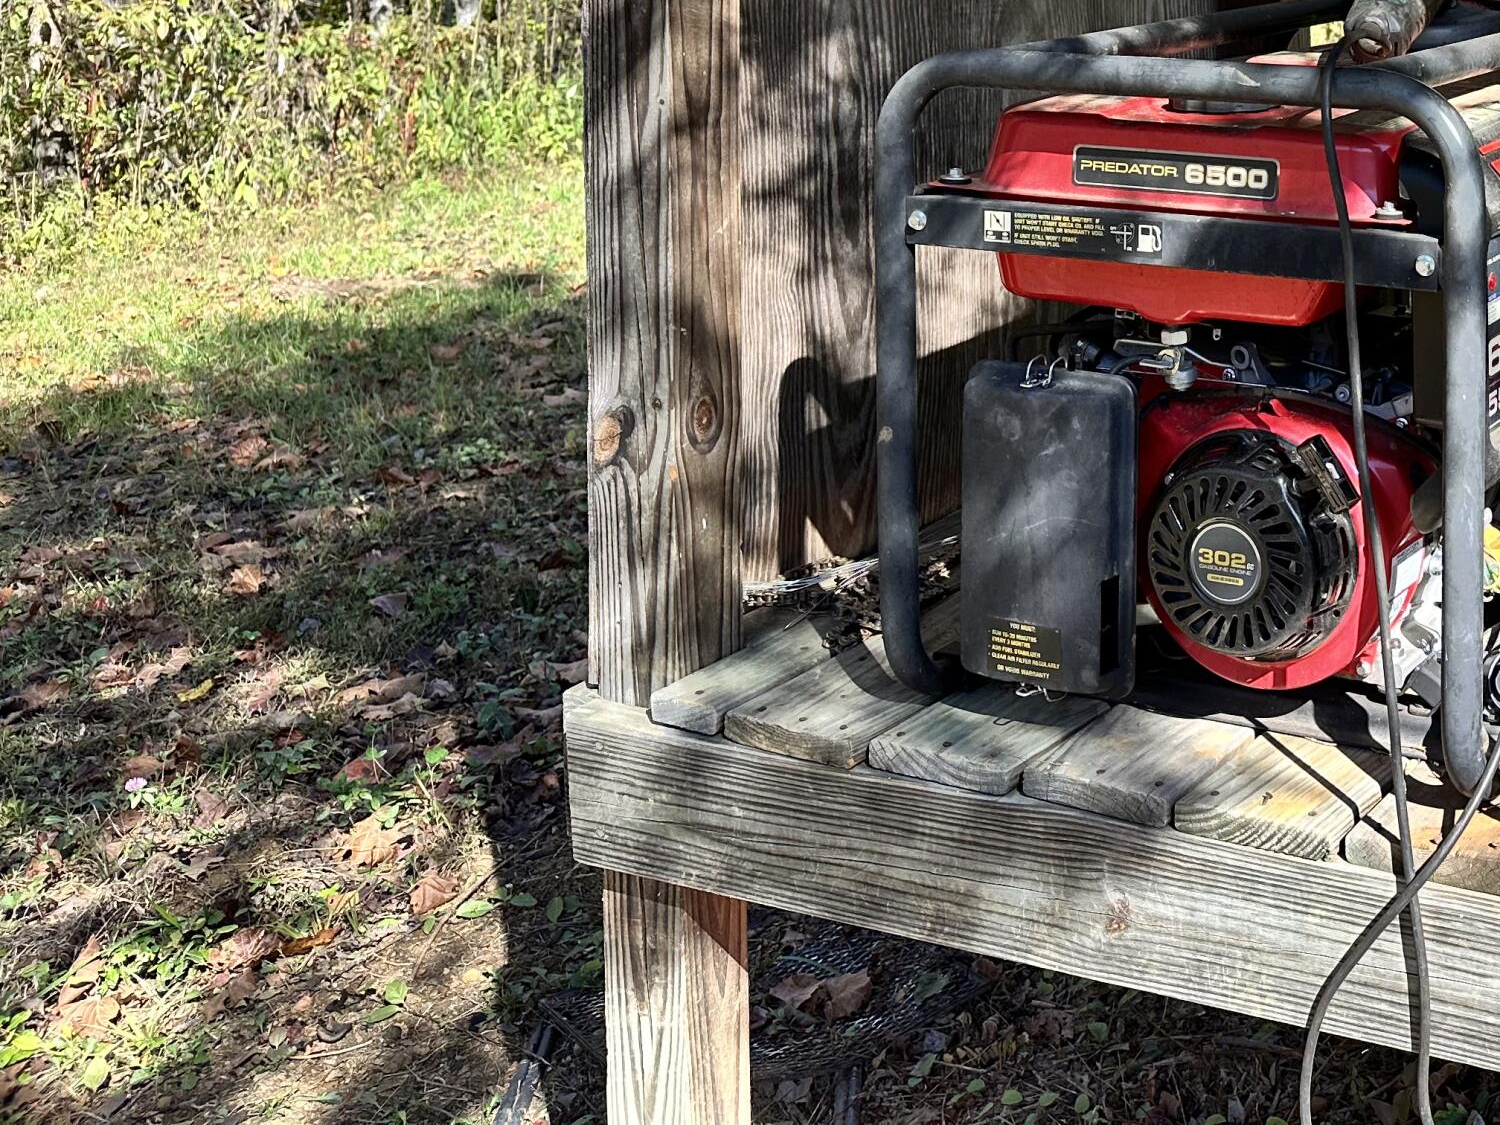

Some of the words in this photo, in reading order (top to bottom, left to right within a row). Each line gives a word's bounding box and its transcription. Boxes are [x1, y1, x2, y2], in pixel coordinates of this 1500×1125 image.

[1080, 159, 1178, 178] PREDATOR
[1184, 163, 1269, 190] 6500
[1198, 547, 1246, 569] 302
[1199, 563, 1229, 573] GASOLINE
[1230, 568, 1253, 576] ENGINE
[1021, 669, 1050, 679] WARRANTY
